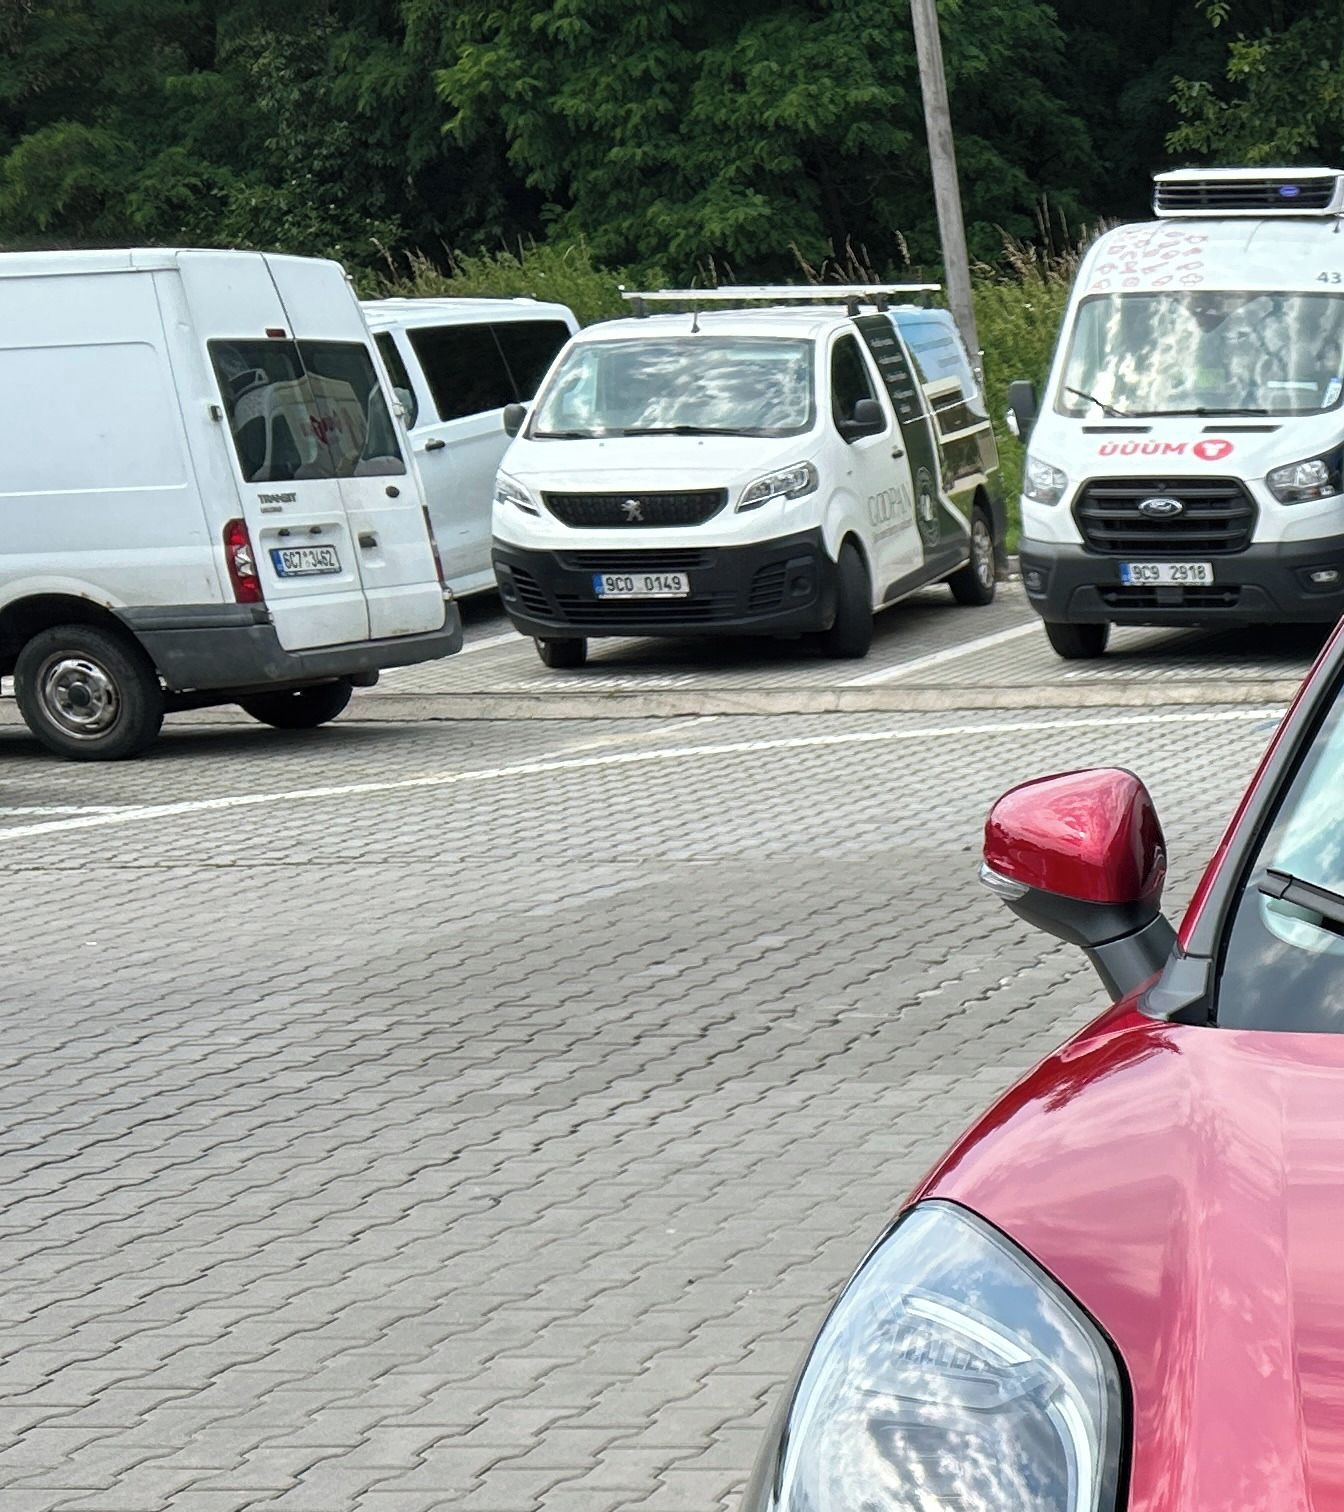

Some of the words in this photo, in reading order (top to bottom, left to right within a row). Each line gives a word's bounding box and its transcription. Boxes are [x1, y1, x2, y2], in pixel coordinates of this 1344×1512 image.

[1315, 271, 1342, 284] 43
[1132, 565, 1160, 581] 9C9
[1169, 565, 1207, 581] 2918
[644, 575, 682, 591] 0149
